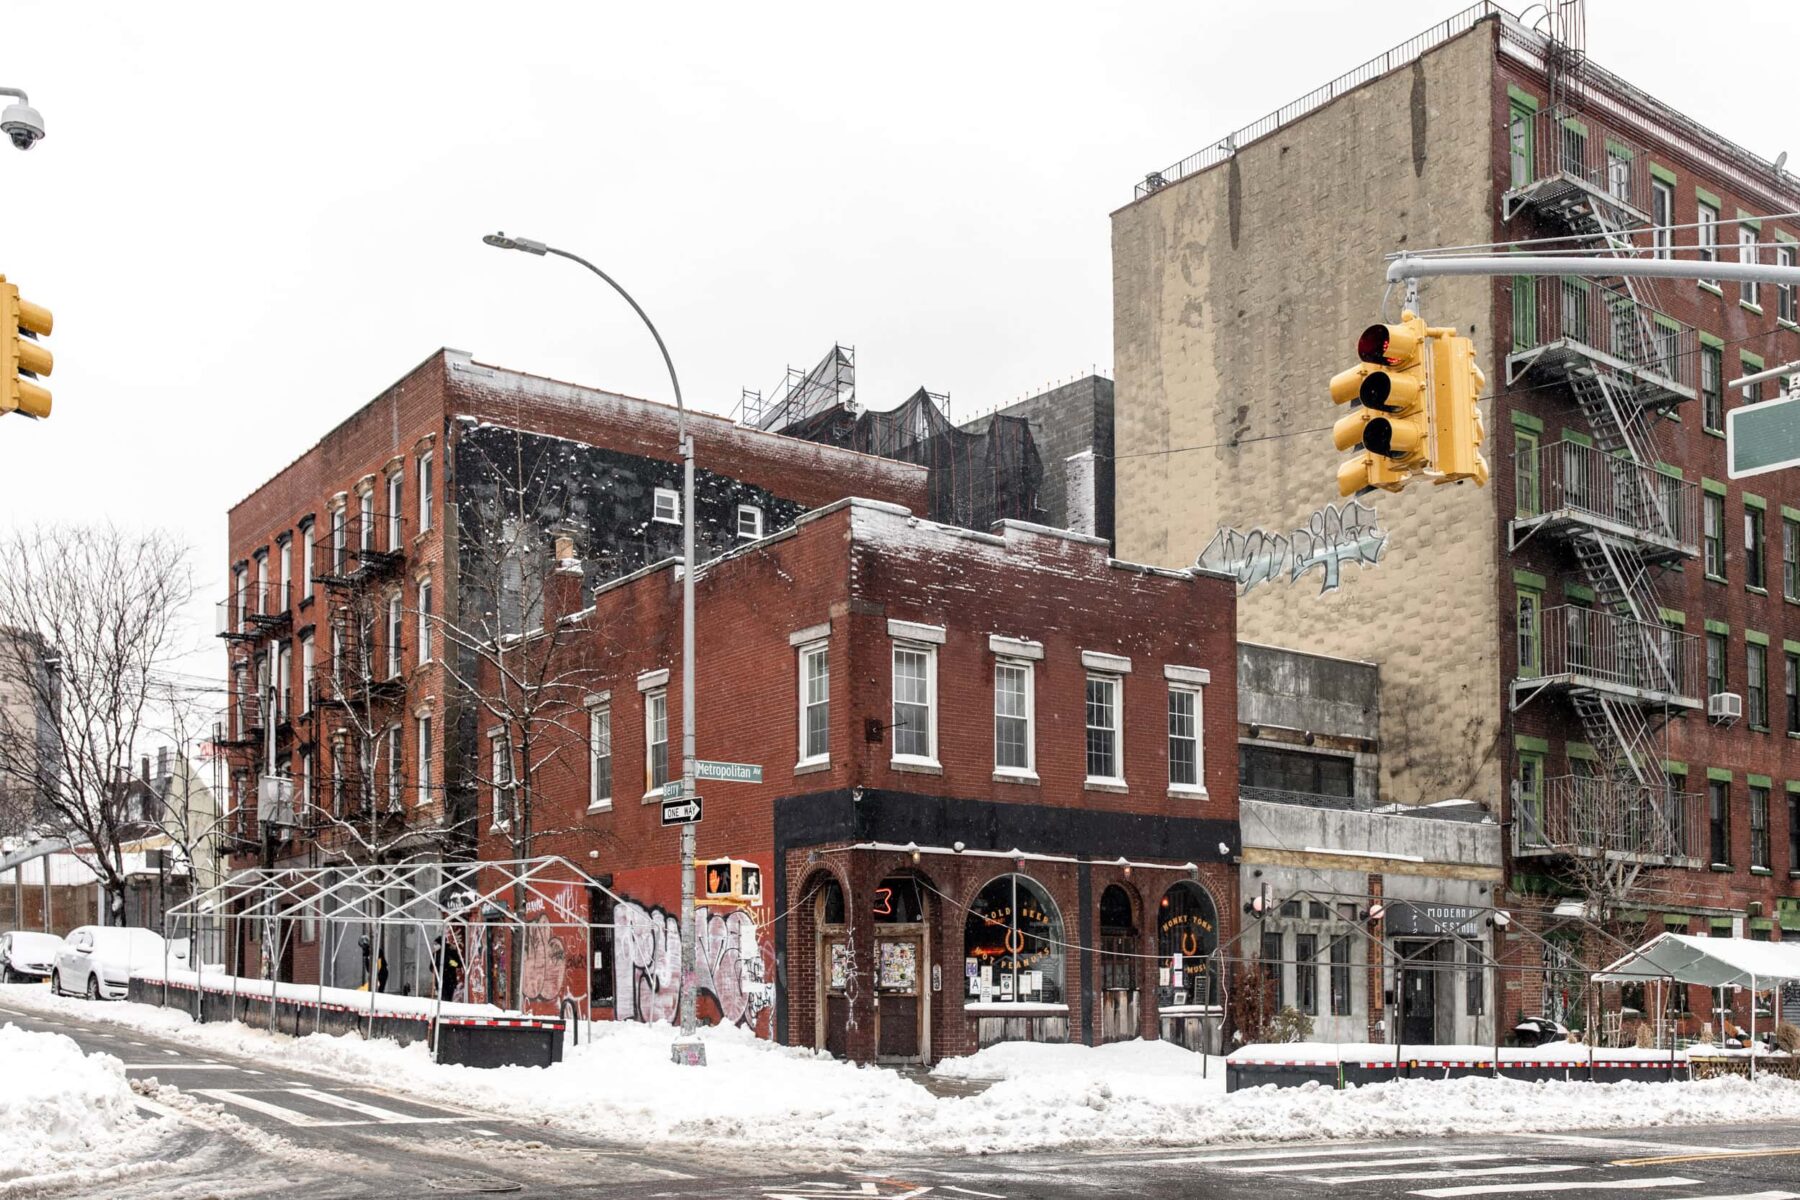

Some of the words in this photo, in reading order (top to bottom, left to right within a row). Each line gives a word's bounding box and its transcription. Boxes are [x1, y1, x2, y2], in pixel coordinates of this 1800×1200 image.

[698, 763, 751, 779] Metropolitan
[667, 807, 679, 818] ONE
[684, 805, 696, 816] WAY
[1022, 908, 1049, 925] BEER
[1428, 908, 1466, 919] MODERN
[1162, 914, 1188, 932] HONKY
[1193, 916, 1212, 932] TONK
[1001, 947, 1050, 969] PEANUTS
[1187, 963, 1206, 974] MUSI
[972, 979, 979, 989] A
